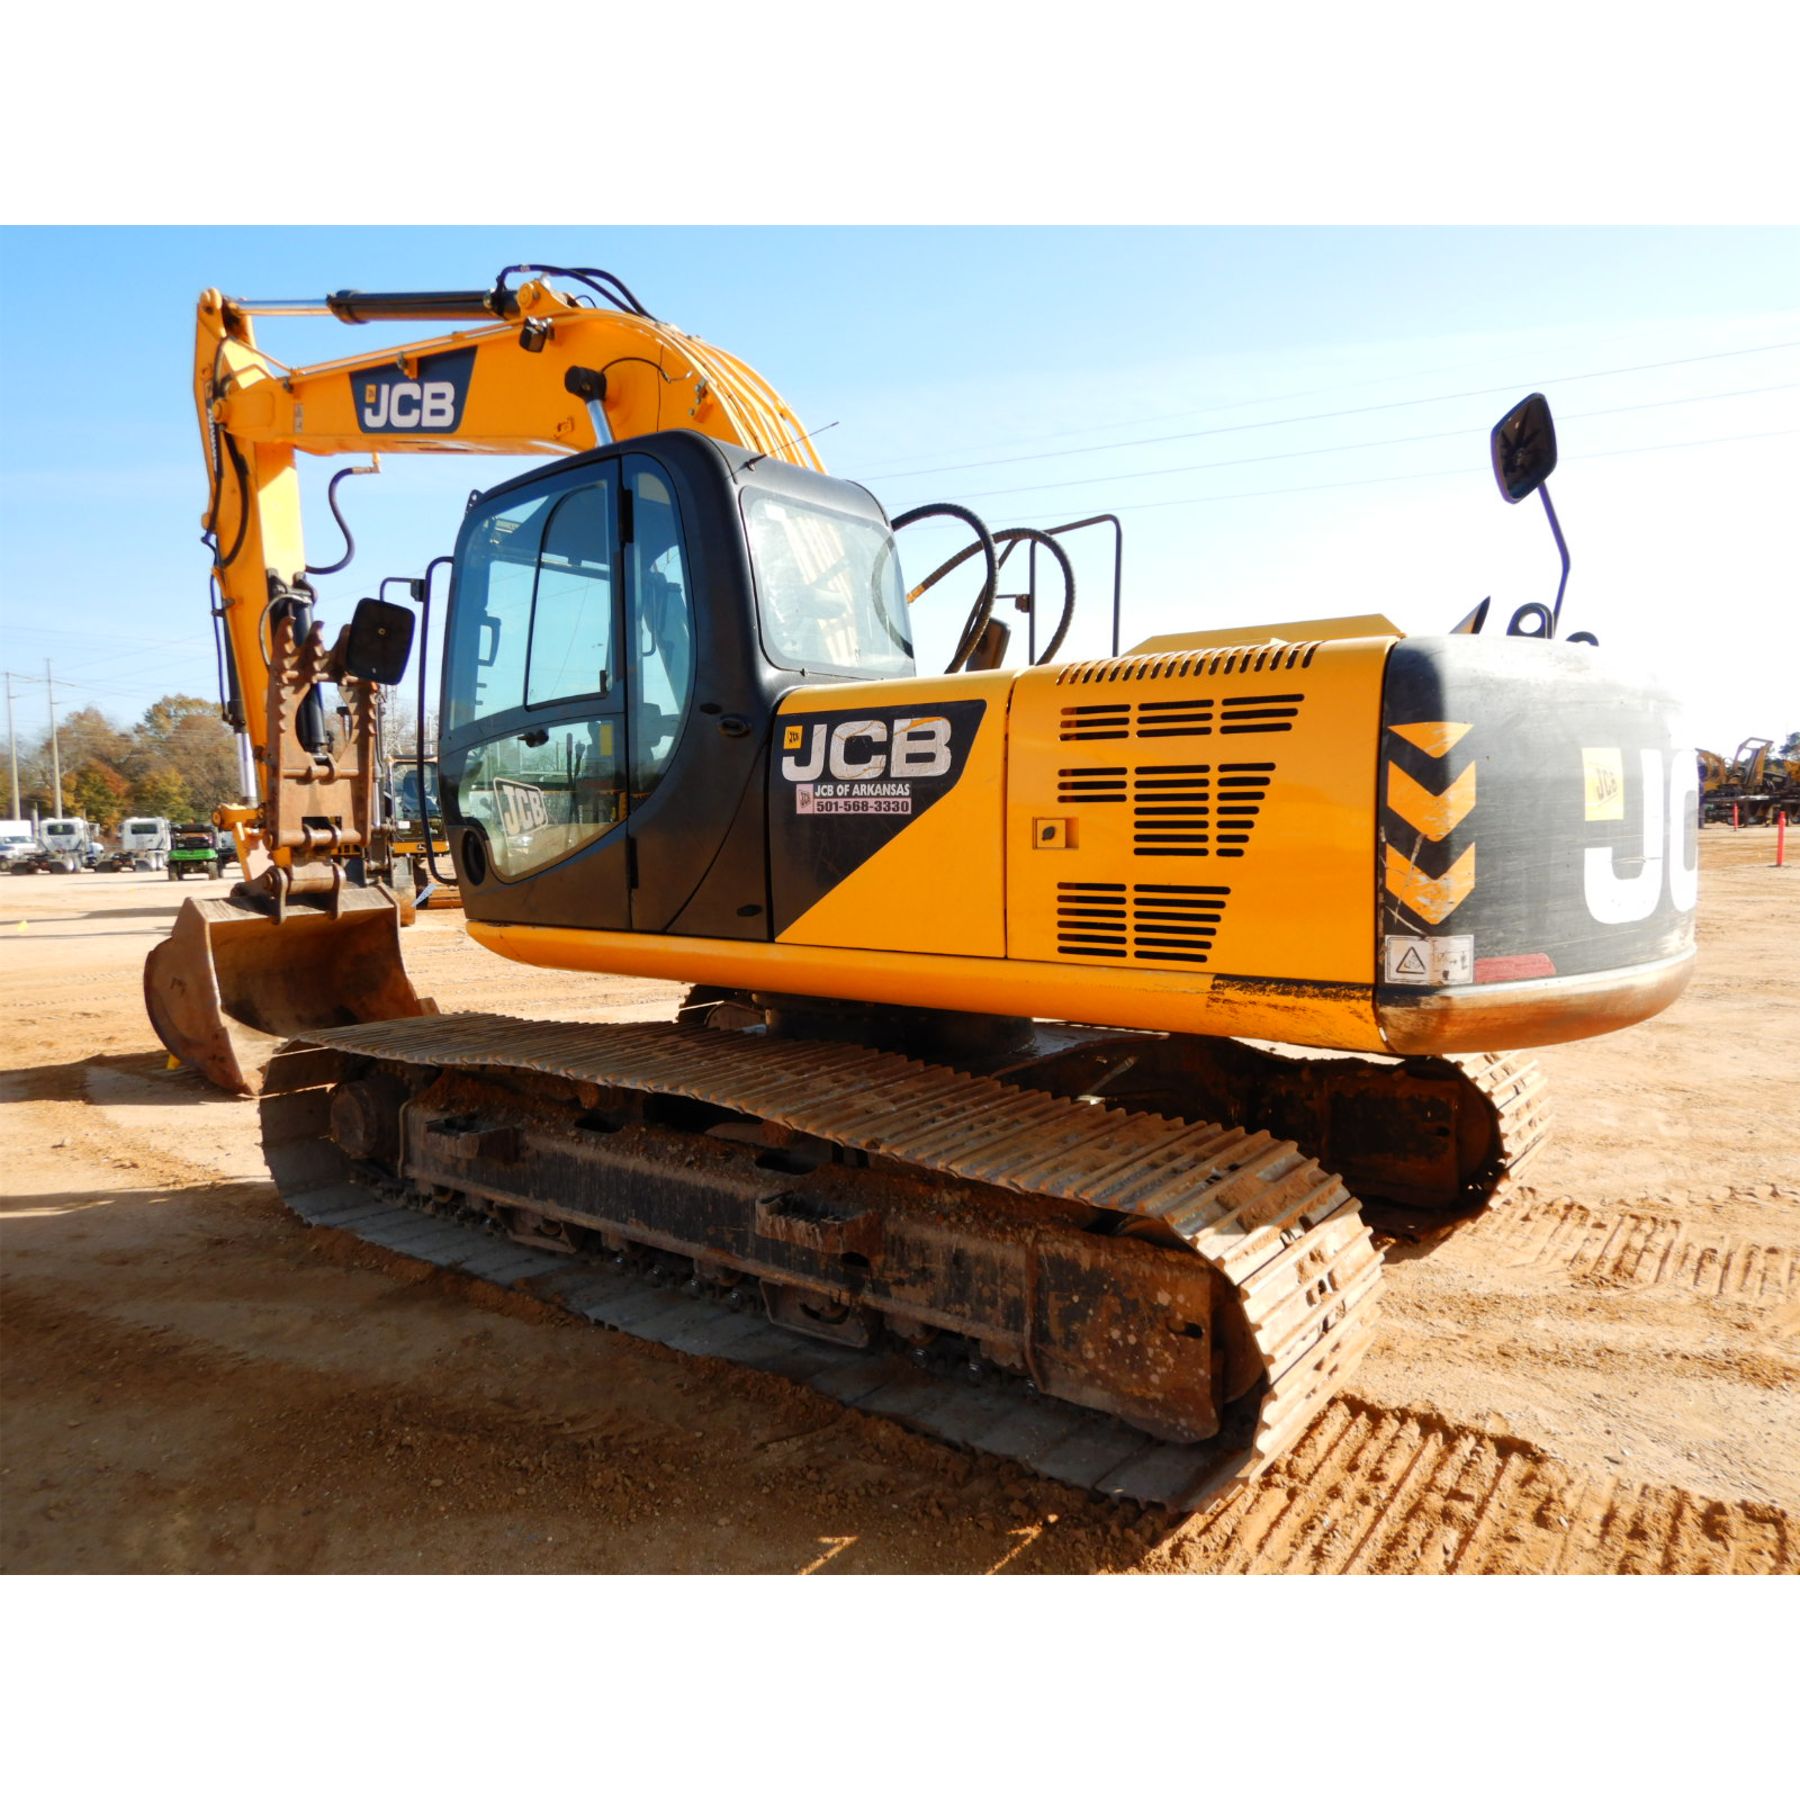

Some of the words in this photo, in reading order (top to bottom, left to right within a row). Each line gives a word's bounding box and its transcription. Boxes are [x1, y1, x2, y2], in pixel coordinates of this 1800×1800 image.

[364, 381, 455, 428] JCB
[781, 716, 952, 782] JCB
[501, 784, 545, 836] JCB
[814, 784, 834, 797] JCB
[836, 784, 850, 796] OF
[852, 783, 910, 796] ARKANSAS
[816, 800, 910, 812] 501-568-3330
